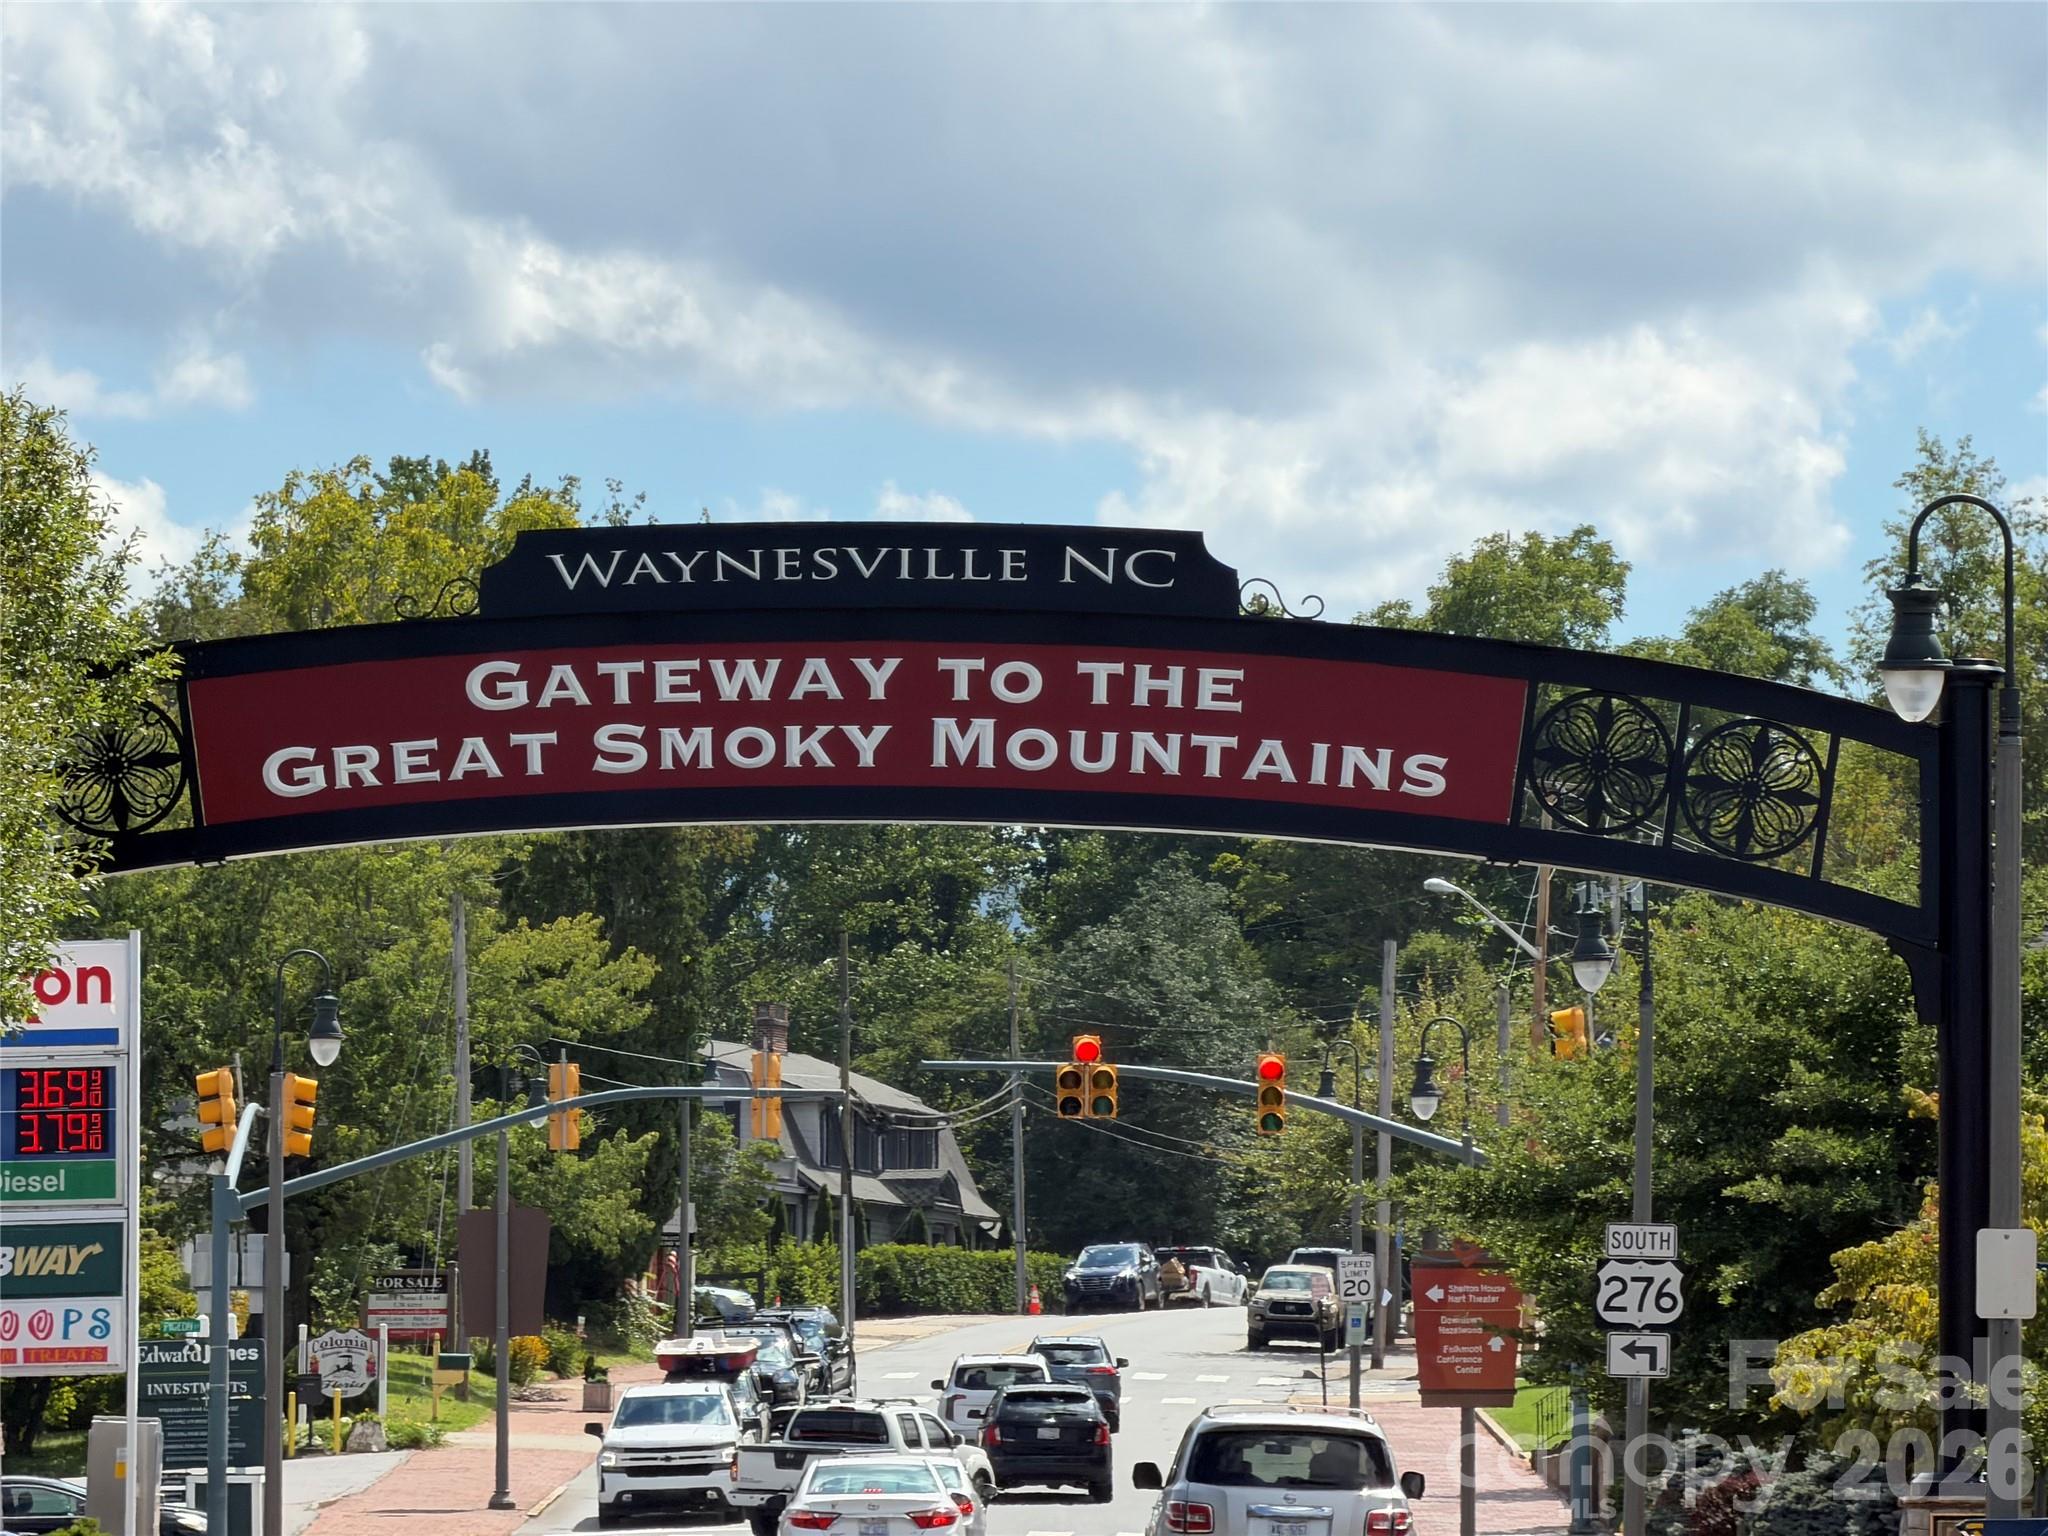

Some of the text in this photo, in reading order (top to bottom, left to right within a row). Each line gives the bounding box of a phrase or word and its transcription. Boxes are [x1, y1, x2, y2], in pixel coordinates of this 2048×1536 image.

[546, 545, 1177, 589] WAYNESVILLE NC
[465, 658, 1244, 713] GATEWAY TO THE
[262, 718, 1448, 798] GREAT SMOKY MOUNTAINS
[0, 1168, 65, 1193] iesel
[1610, 1230, 1671, 1251] SOUTH
[1340, 1260, 1371, 1269] SPEED
[1344, 1269, 1368, 1278] LIMIT
[376, 1277, 443, 1289] FOR SALE
[1343, 1280, 1371, 1297] 20
[1481, 1284, 1506, 1293] House
[1448, 1294, 1500, 1303] Hart Theater
[1603, 1275, 1678, 1314] 276
[138, 1344, 260, 1365] Edward Jnes
[1436, 1355, 1483, 1364] Conference
[1455, 1366, 1483, 1374] Center
[147, 1381, 248, 1396] INVESTMTS
